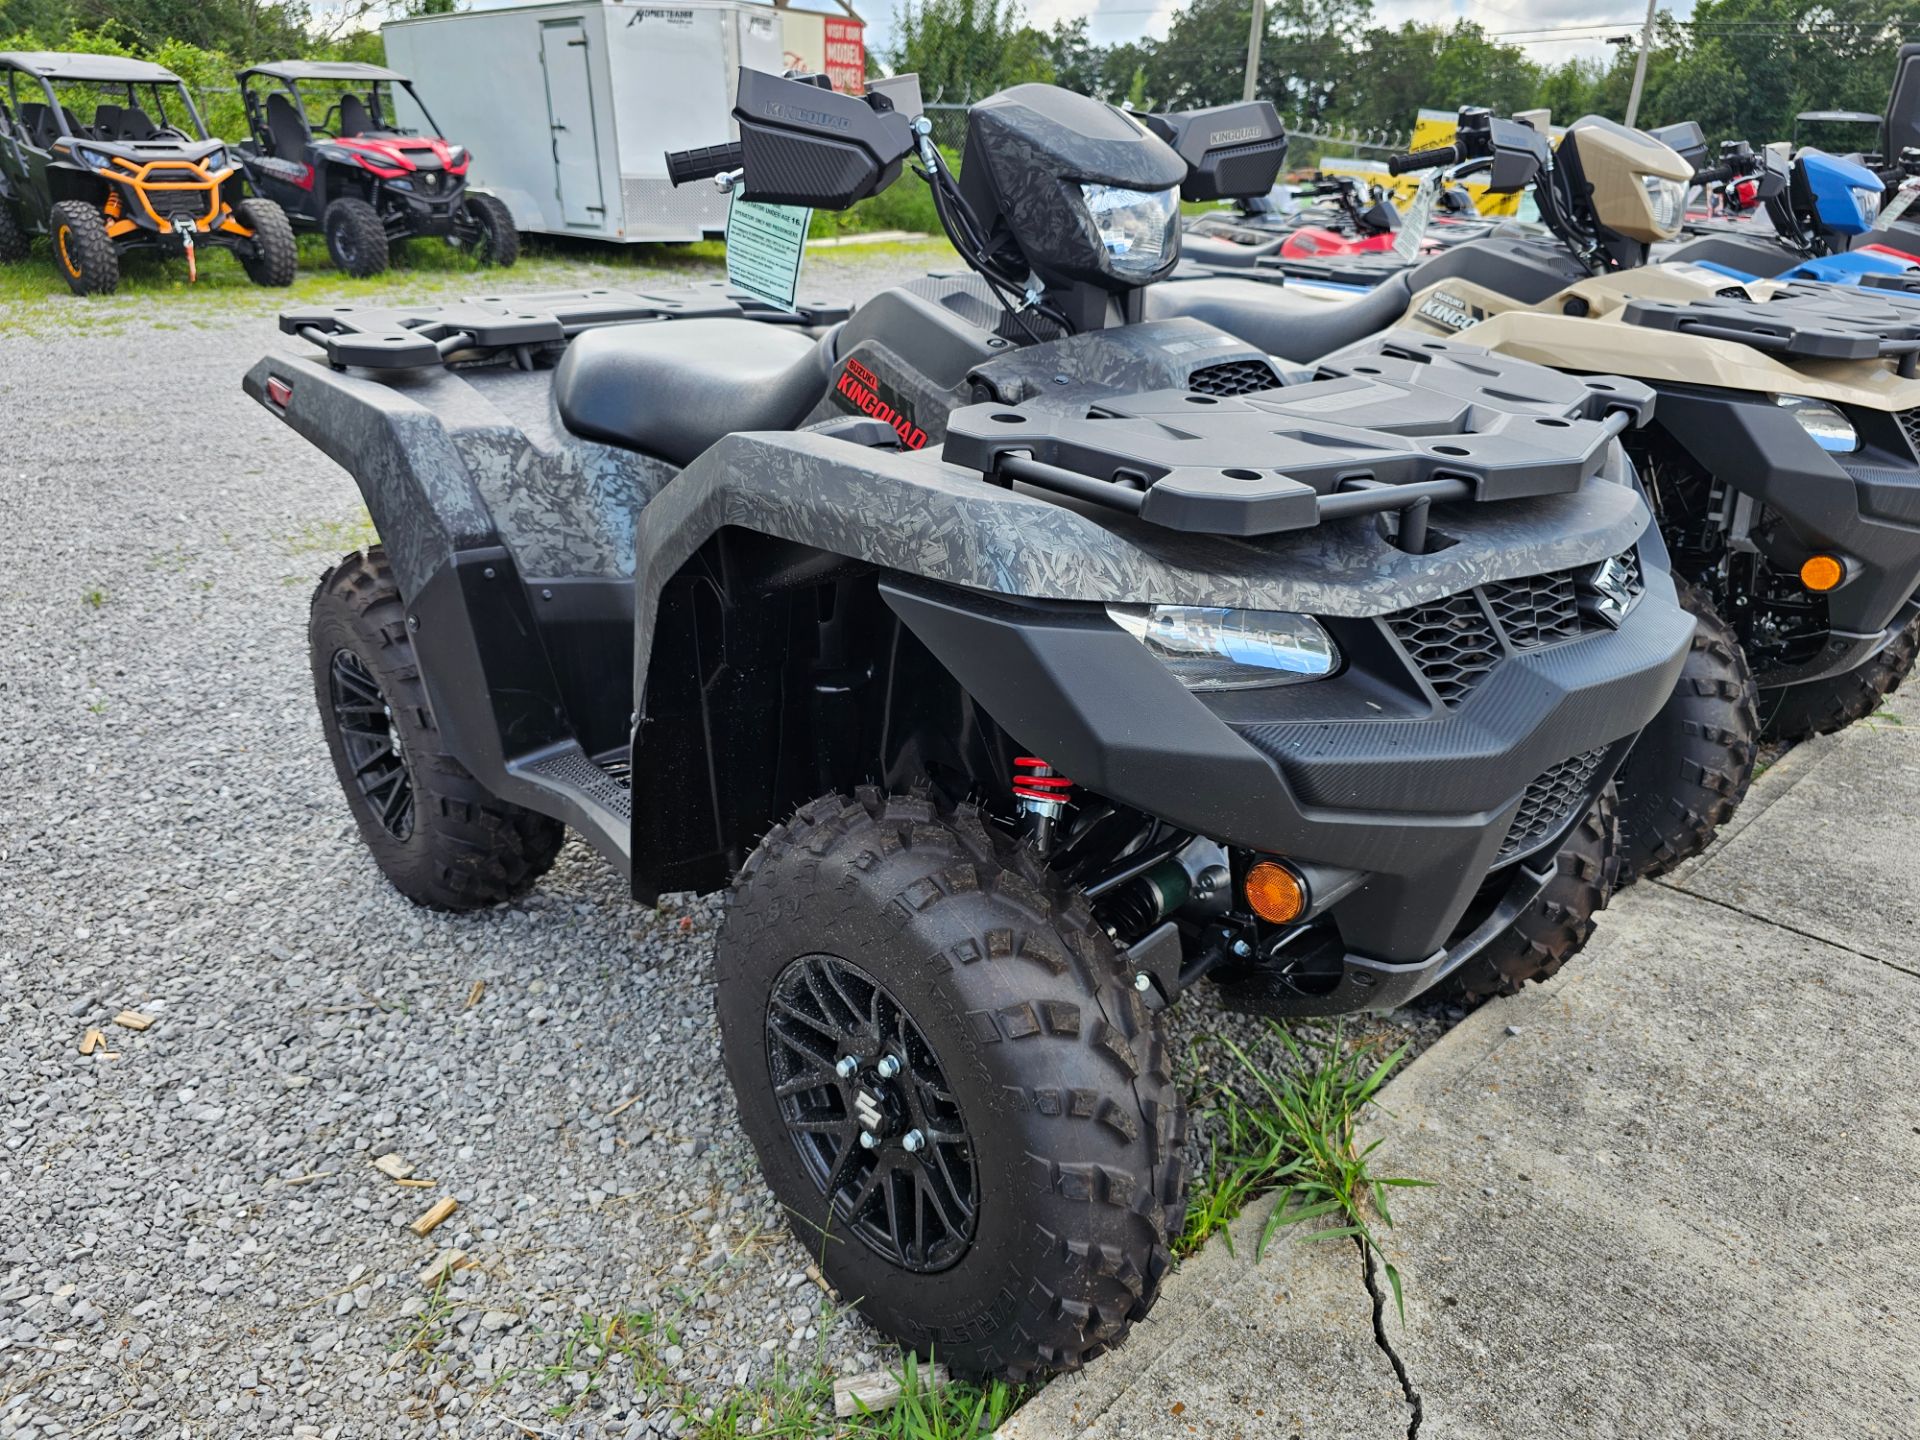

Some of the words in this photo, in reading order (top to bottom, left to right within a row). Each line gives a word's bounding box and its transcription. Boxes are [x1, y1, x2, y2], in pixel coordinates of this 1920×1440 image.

[827, 42, 862, 65] MODEL
[764, 101, 850, 132] KINGQUAD
[1210, 126, 1261, 145] KINGQUAD
[1421, 301, 1479, 329] KINGQ
[848, 359, 876, 388] SUZUKI
[837, 373, 928, 450] KINGQUAD
